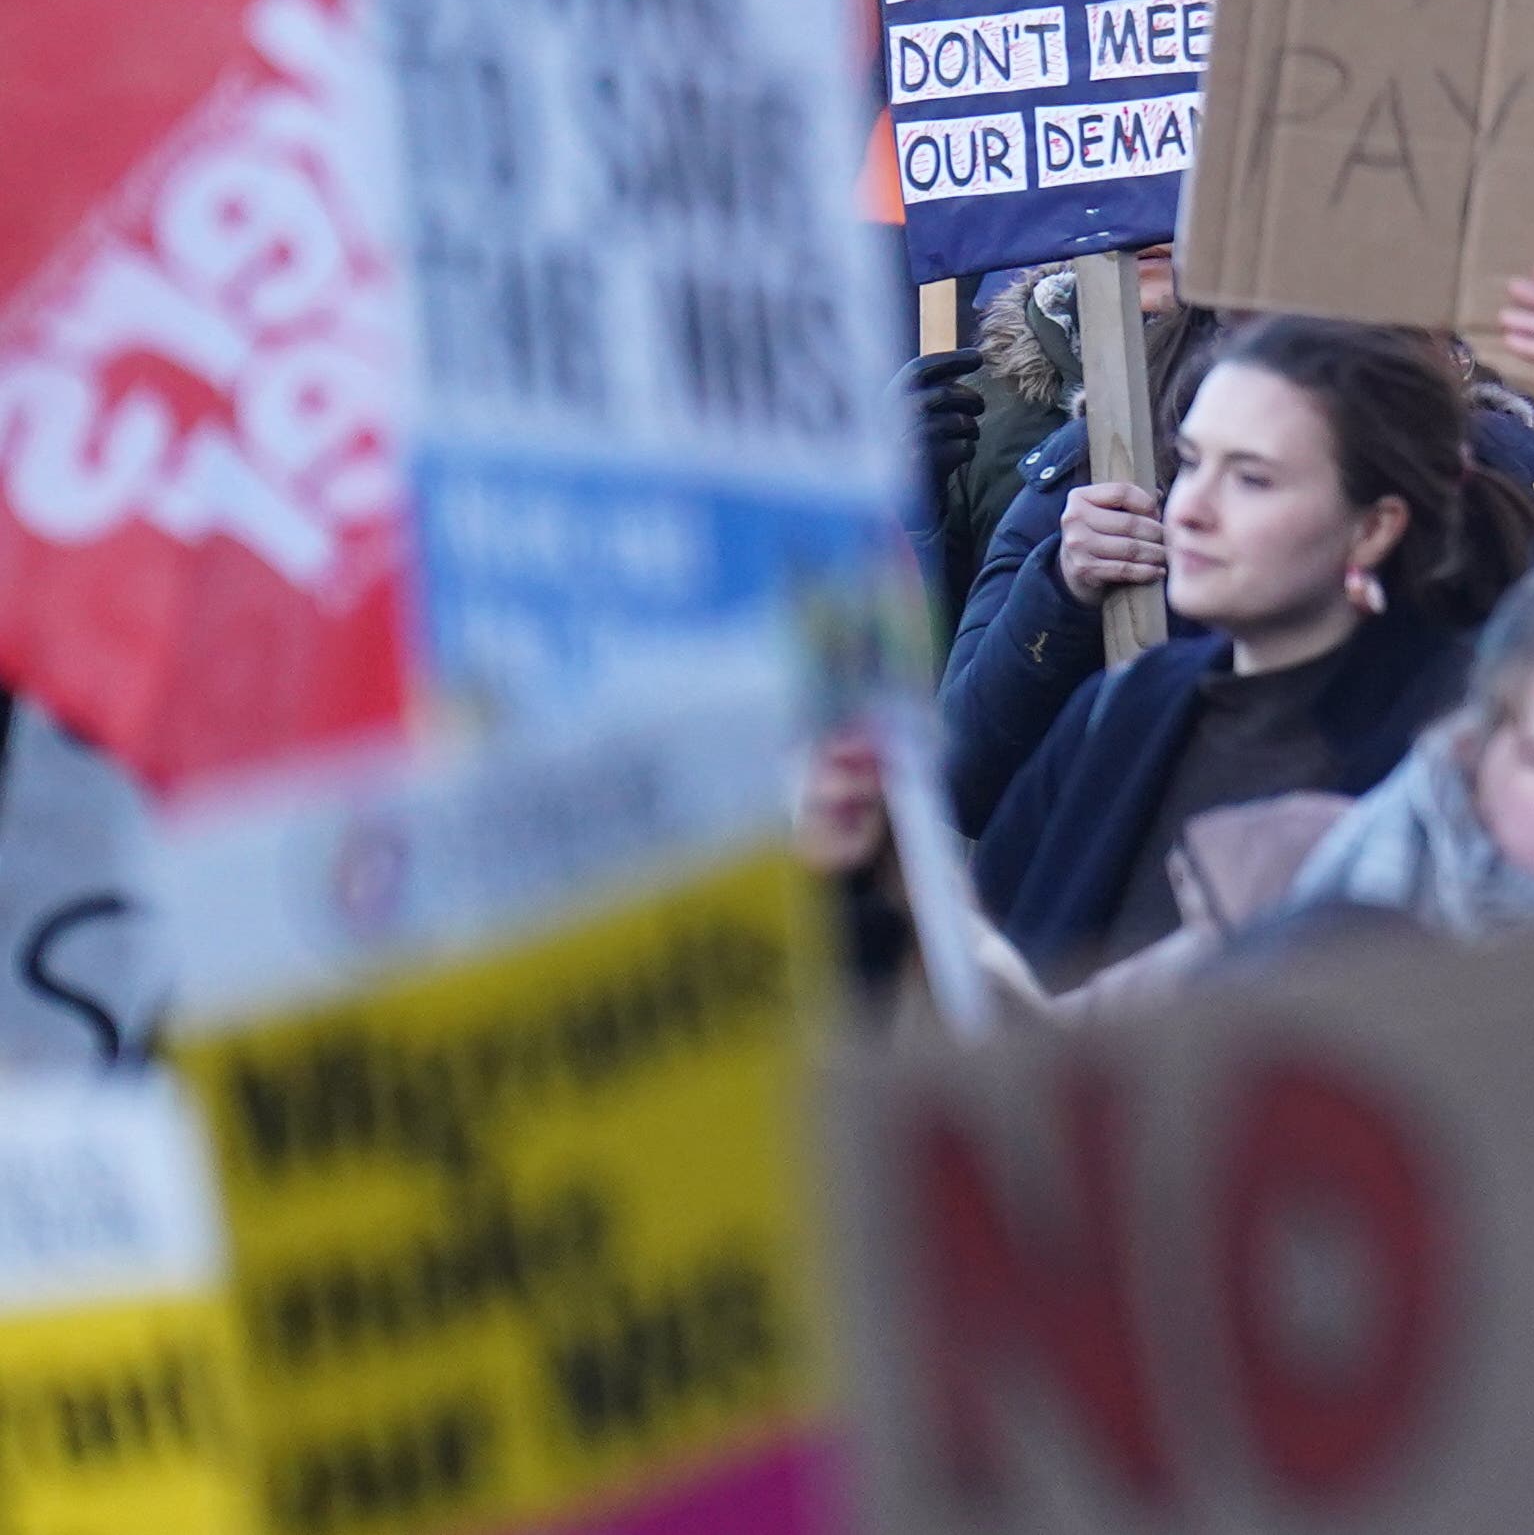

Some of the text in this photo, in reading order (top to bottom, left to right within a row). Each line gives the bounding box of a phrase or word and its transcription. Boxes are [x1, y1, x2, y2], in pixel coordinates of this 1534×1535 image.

[899, 1, 1211, 93] DON'T MEE
[904, 106, 1202, 192] OUR DEMA
[1240, 44, 1530, 221] PAY
[908, 1036, 1460, 1516] NO
